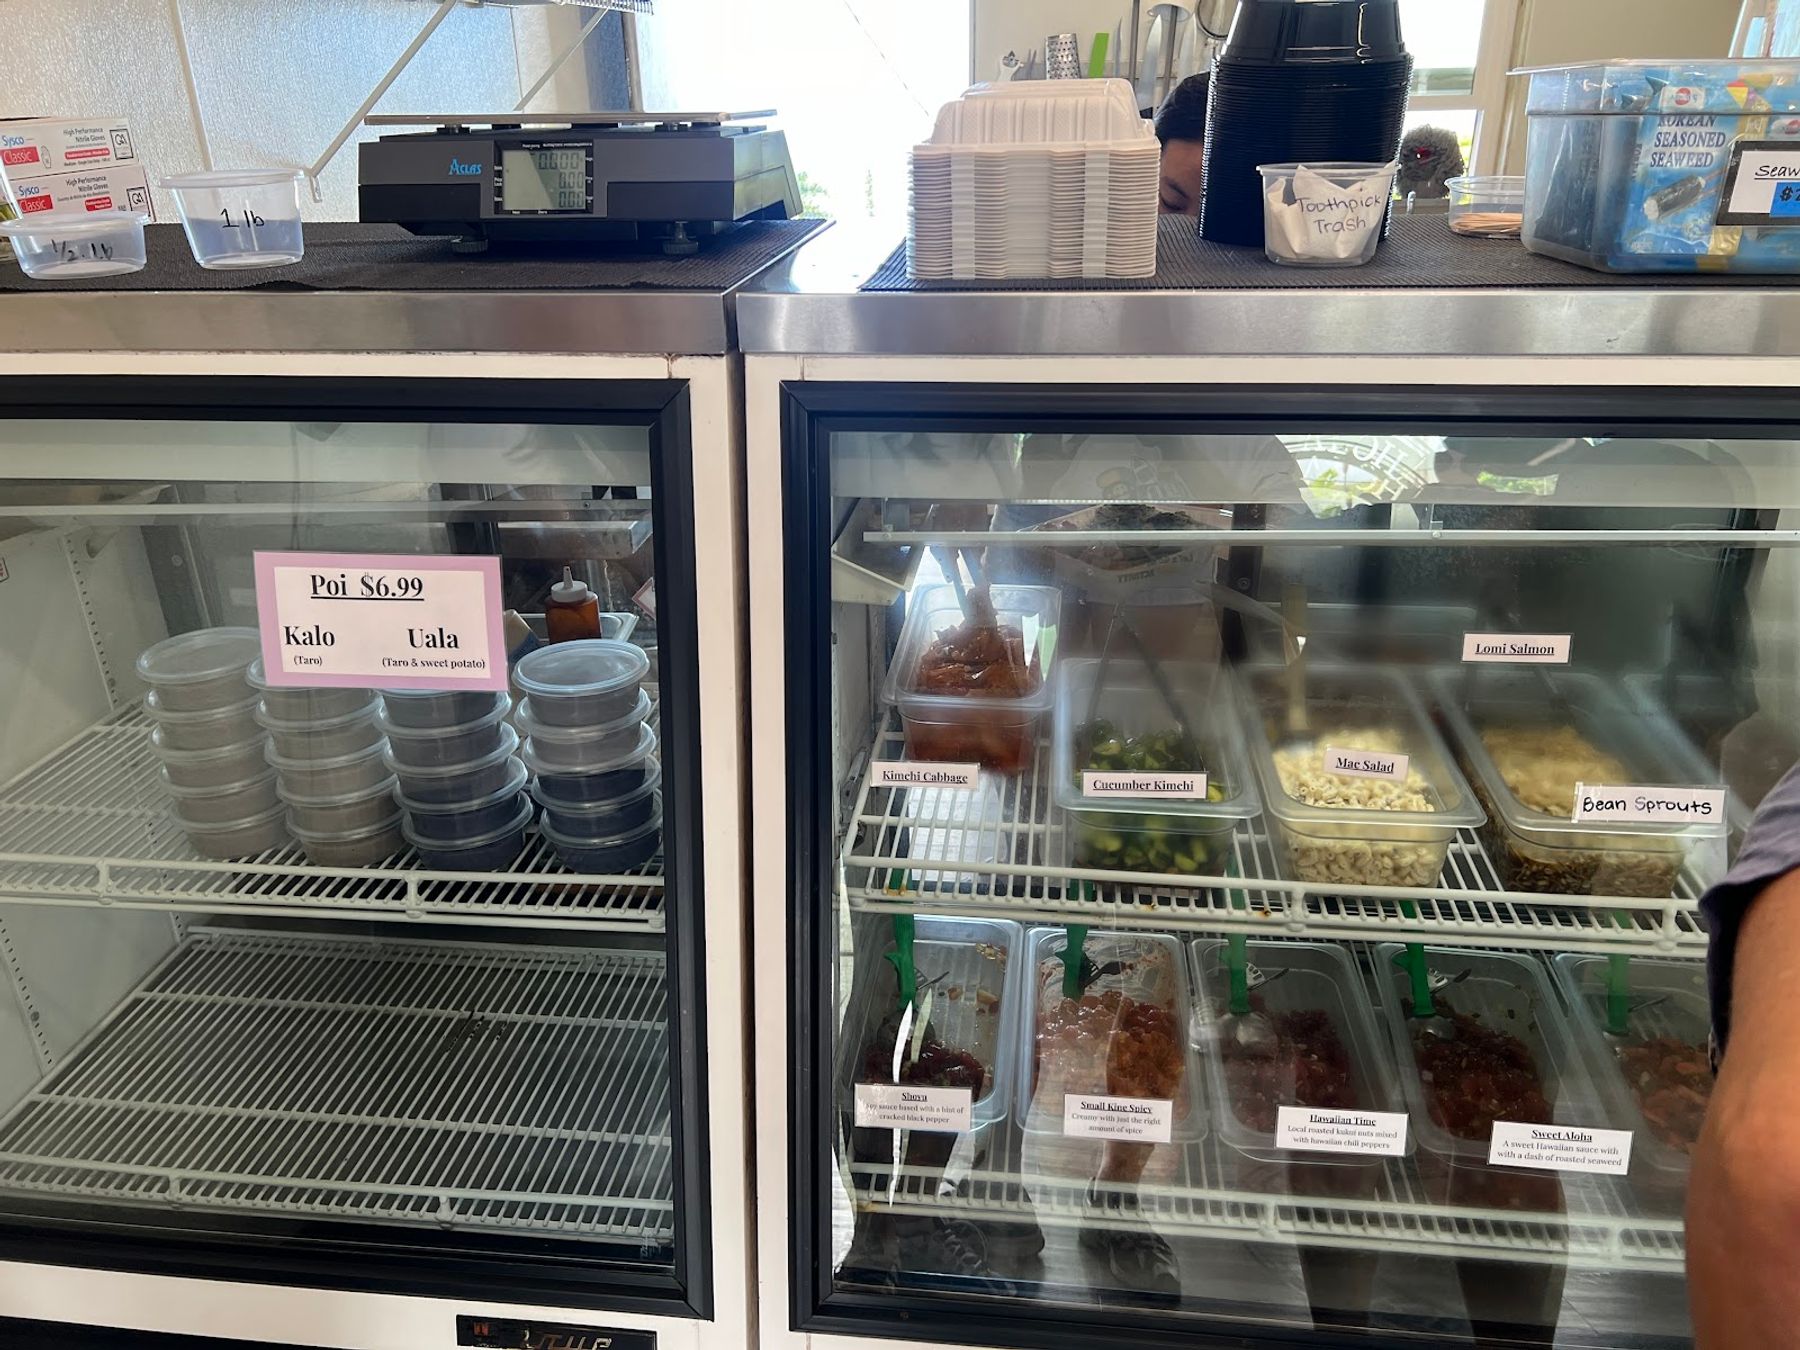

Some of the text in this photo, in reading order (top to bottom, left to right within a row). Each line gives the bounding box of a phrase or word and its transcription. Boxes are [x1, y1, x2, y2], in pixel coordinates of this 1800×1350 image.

[1658, 115, 1716, 127] KOREAN
[74, 127, 103, 135] Performance
[2, 135, 25, 147] Sysco
[1654, 131, 1726, 148] SEASONED
[3, 151, 33, 164] Classic
[1650, 152, 1714, 167] SEAWEED
[66, 175, 107, 187] High Performance
[94, 183, 108, 191] Gloves
[19, 186, 40, 197] Sysco
[20, 199, 47, 213] Classic
[1295, 194, 1381, 213] Toothpick
[221, 208, 265, 228] 1 lb
[1313, 218, 1366, 234] Trash
[310, 571, 424, 598] Poi $6.99
[284, 624, 336, 647] Kalo
[407, 627, 460, 649] Uala
[1476, 643, 1555, 655] Lomi Salmon
[293, 655, 323, 666] (Taro)
[382, 657, 486, 670] (Taro & sweet potato)
[1336, 757, 1394, 773] Mac Salad
[882, 770, 969, 784] Kimchi Cabbage
[1093, 779, 1194, 791] Cucumber Kimchi
[1582, 796, 1712, 815] Bean Sprouts
[899, 1104, 918, 1112] based
[1081, 1101, 1153, 1114] Small Kine Spicy
[907, 1114, 924, 1122] black
[926, 1116, 950, 1124] pepper
[1072, 1113, 1161, 1126] Creamy with just the right
[1310, 1114, 1377, 1127] Hawaiian Time
[1116, 1125, 1125, 1133] of
[1125, 1127, 1143, 1136] spice
[1308, 1127, 1335, 1135] roasted
[1336, 1128, 1356, 1136] kukui
[1375, 1130, 1398, 1139] mixed
[1532, 1129, 1592, 1142] Sweet Aloha
[1293, 1136, 1310, 1144] with
[1310, 1137, 1342, 1146] hawaiian
[1361, 1141, 1390, 1149] peppers
[1536, 1143, 1574, 1152] Hawaiian
[1600, 1147, 1619, 1155] with
[1497, 1151, 1516, 1159] with
[1524, 1152, 1543, 1160] dash
[1555, 1155, 1585, 1164] roasted
[1587, 1157, 1622, 1166] seaweed
